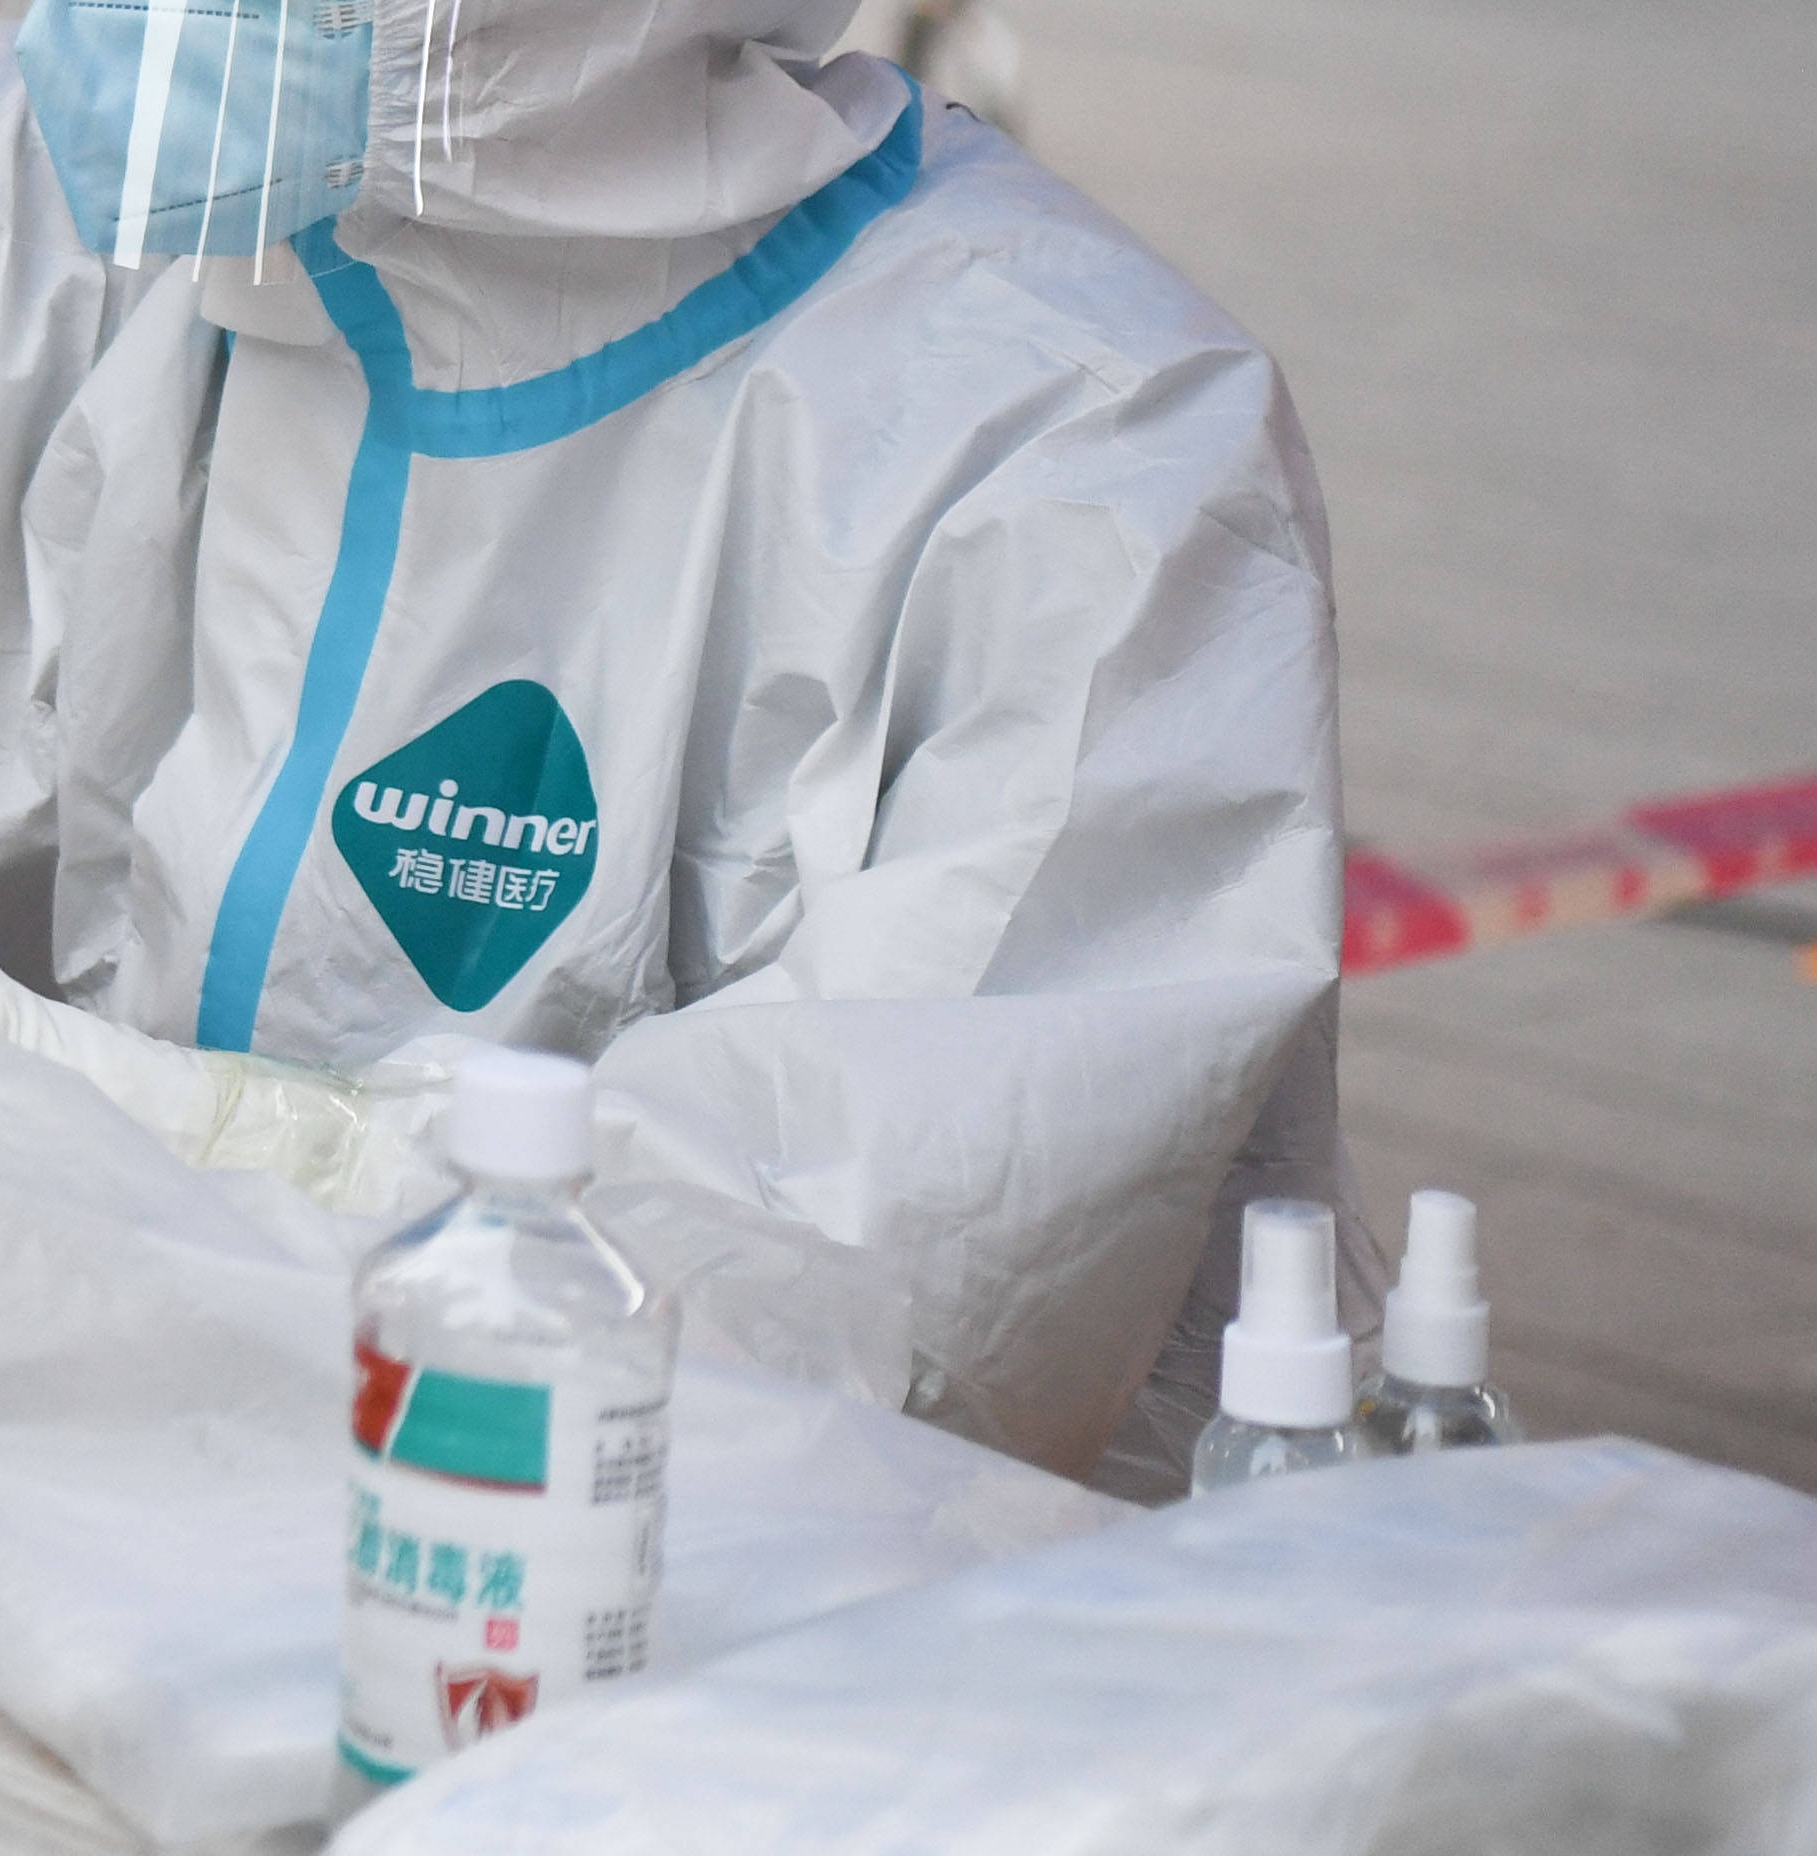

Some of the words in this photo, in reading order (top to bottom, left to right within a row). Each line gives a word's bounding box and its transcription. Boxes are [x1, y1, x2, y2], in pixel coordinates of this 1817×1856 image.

[353, 778, 597, 856] winner
[387, 847, 561, 912] 稳健医疗
